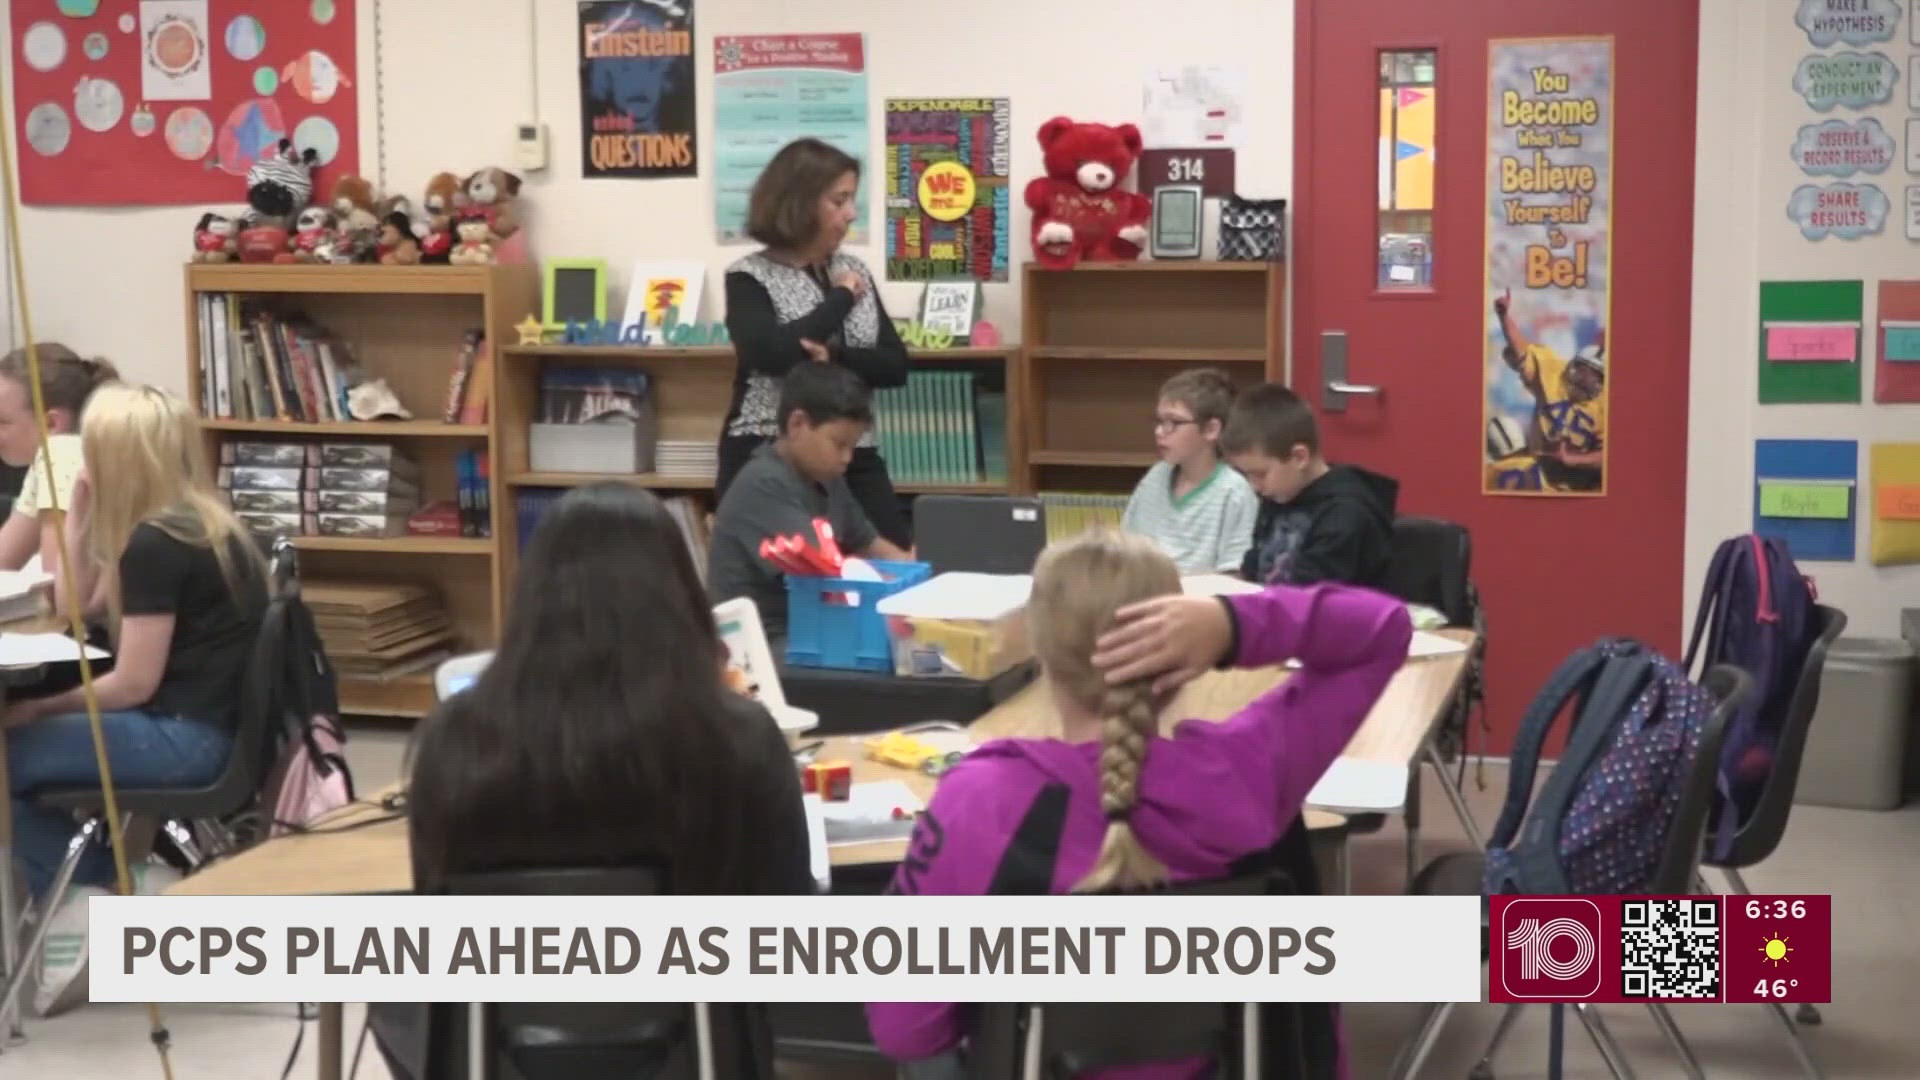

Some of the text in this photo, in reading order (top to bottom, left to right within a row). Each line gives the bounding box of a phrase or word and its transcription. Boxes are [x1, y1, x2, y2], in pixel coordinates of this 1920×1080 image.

[1814, 17, 1885, 33] HYPOTHESIS
[585, 22, 691, 58] Einstein
[1531, 67, 1568, 94] You
[1808, 62, 1861, 79] CONDUCT
[1814, 81, 1883, 98] EXPERIMENT
[1503, 91, 1598, 127] Become
[590, 134, 692, 170] QUESTIONS
[1167, 158, 1205, 182] 314
[1501, 152, 1596, 193] Believe
[926, 173, 967, 196] WE
[1504, 196, 1592, 226] Yourself
[1818, 193, 1860, 208] SHARE
[1811, 210, 1867, 226] RESULTS
[1526, 243, 1588, 289] Be!
